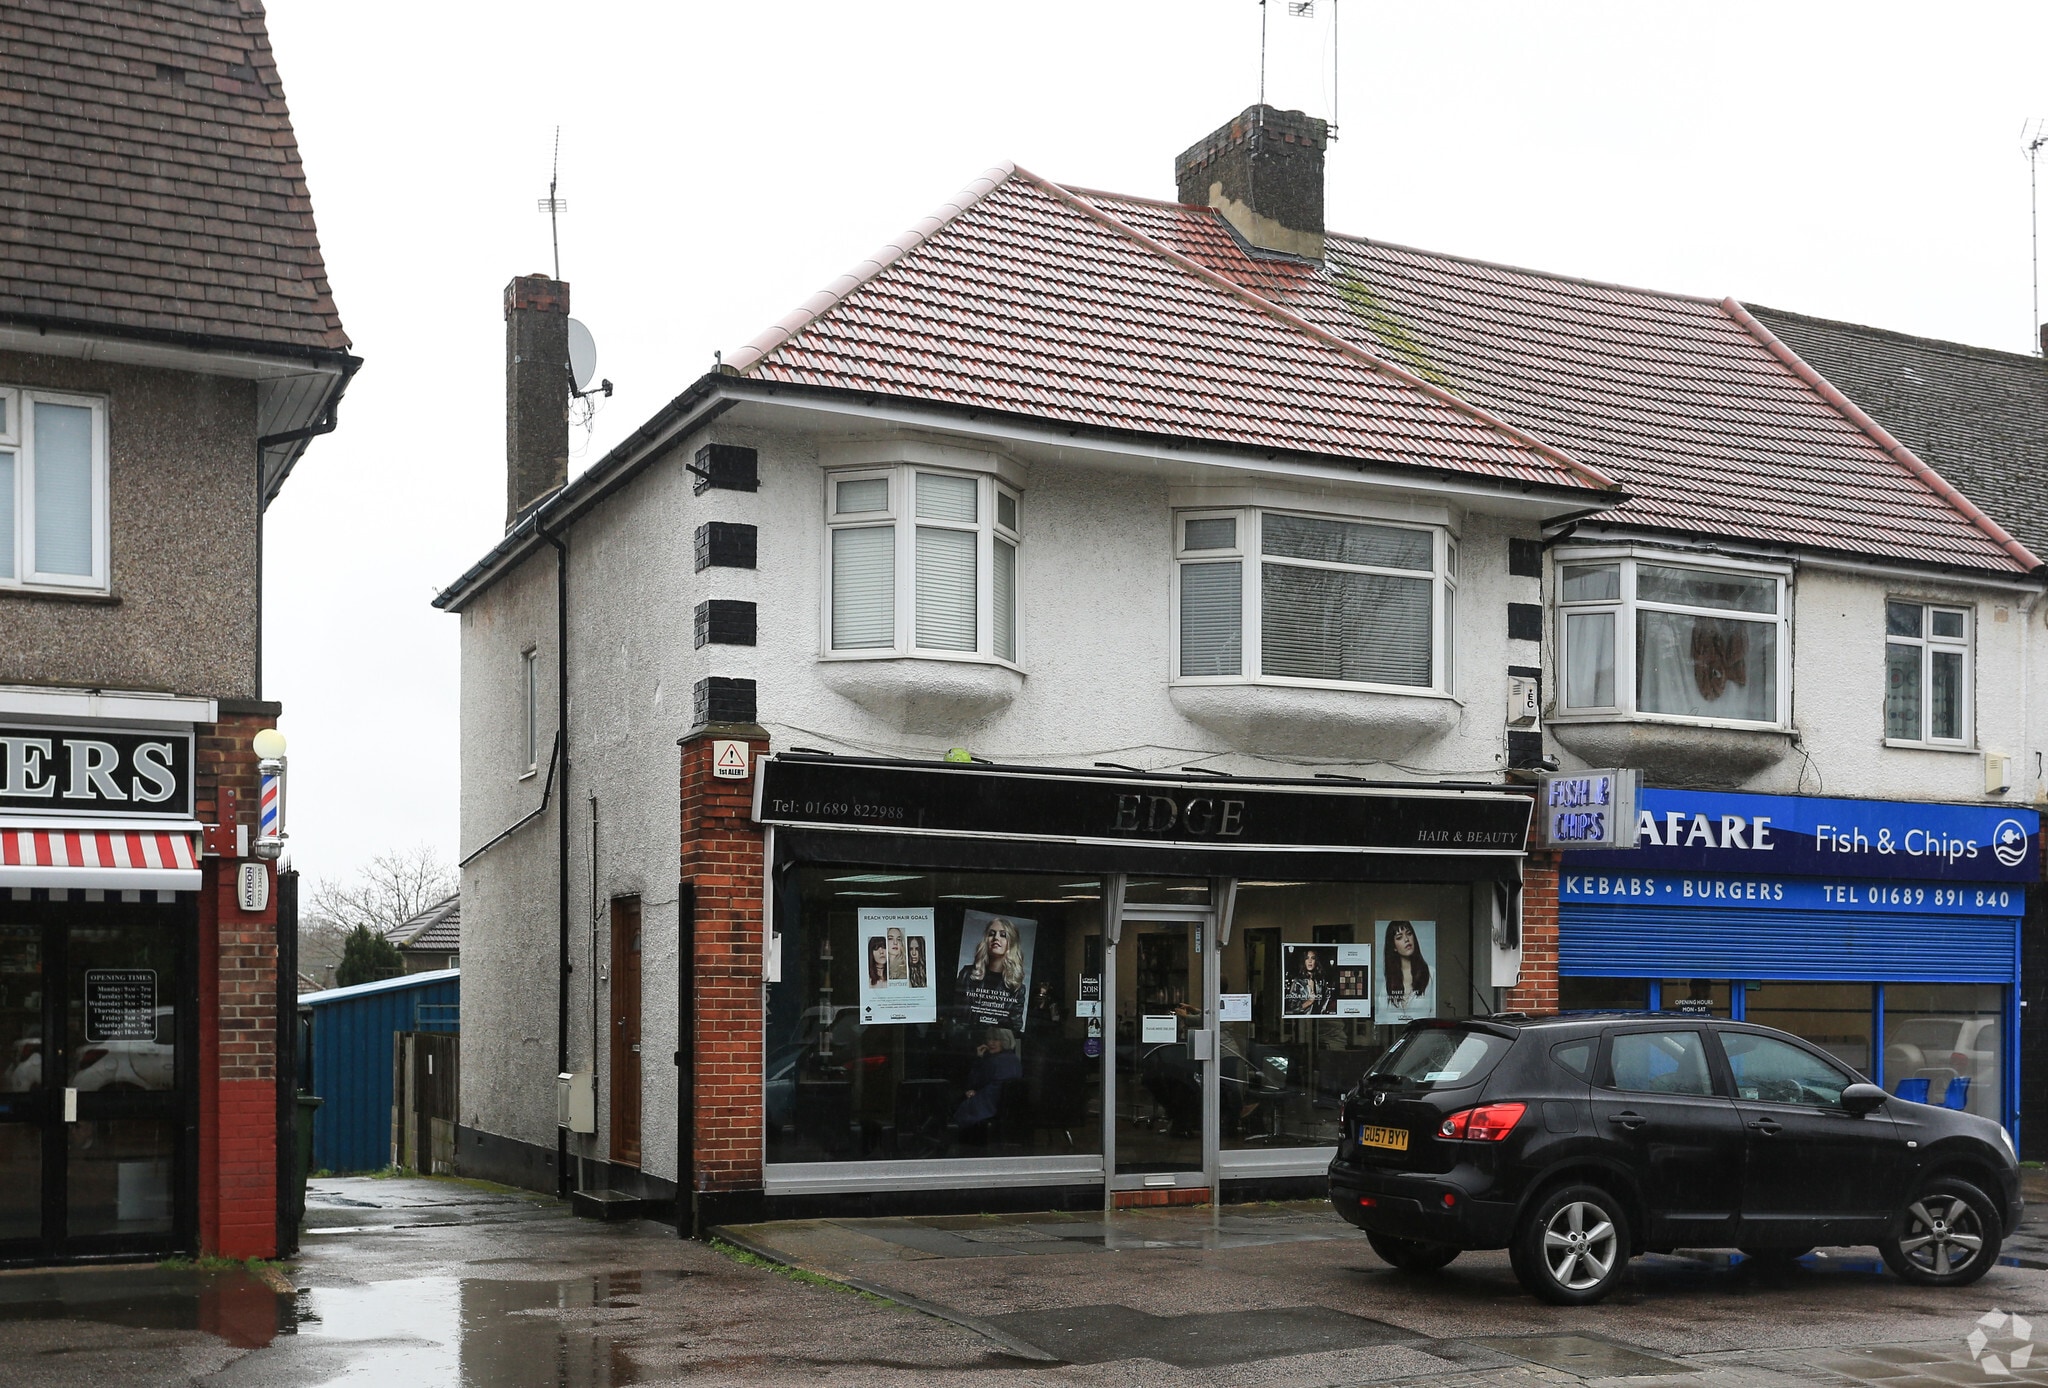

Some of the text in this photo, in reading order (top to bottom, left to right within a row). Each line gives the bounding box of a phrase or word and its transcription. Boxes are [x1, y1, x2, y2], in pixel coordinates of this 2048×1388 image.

[719, 768, 745, 776] 1st ALERT
[1549, 777, 1609, 808] FISH &
[773, 799, 904, 819] Tel: 01689 822988
[1110, 793, 1245, 836] EDGE
[1418, 830, 1518, 844] HAIR & BEAUTY
[1553, 812, 1604, 841] CHIPS
[1634, 810, 1775, 851] AFARE
[1816, 824, 1978, 865] Fish & Chips
[1566, 876, 1784, 901] KEBABS BURGERS
[1823, 885, 2010, 908] TEL 01689 891 840
[1082, 985, 1099, 993] 2018
[1364, 1126, 1407, 1147] GU57 BYY
